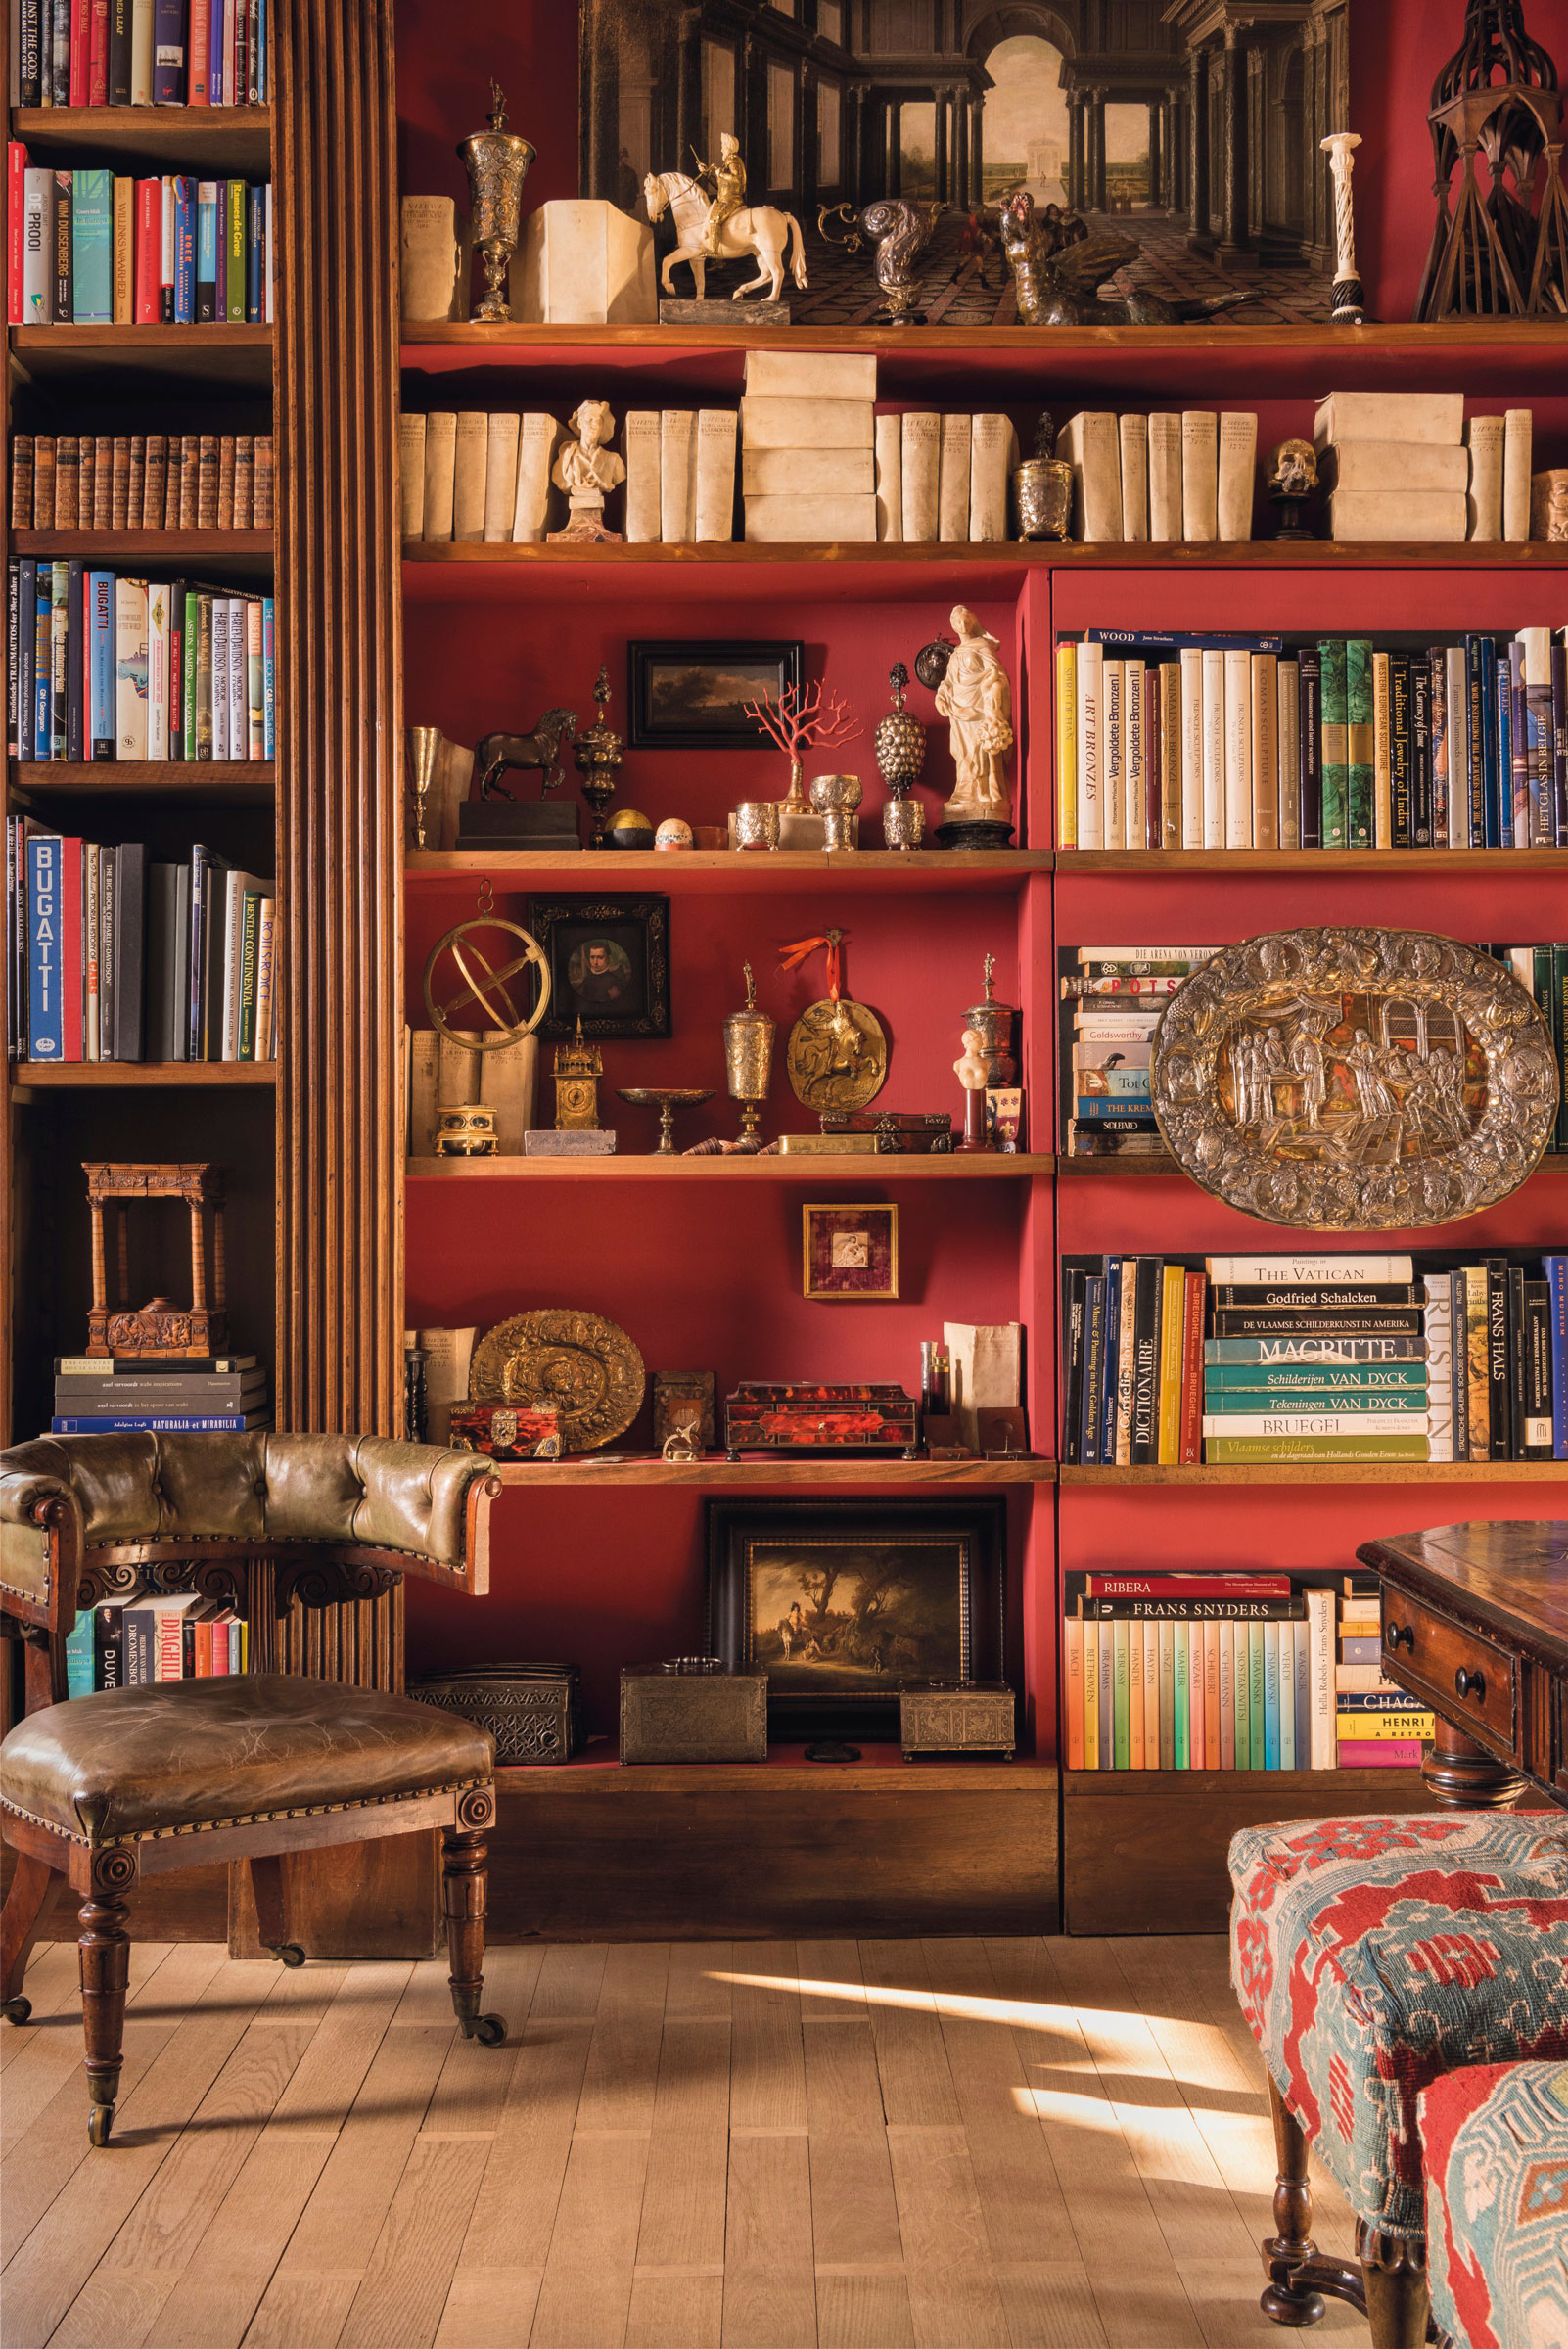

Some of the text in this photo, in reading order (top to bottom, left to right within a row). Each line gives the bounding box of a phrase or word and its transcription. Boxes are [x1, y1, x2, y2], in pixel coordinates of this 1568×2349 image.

[22, 55, 27, 64] OF
[28, 1, 37, 80] INST THE GODS
[28, 193, 41, 251] DE PROOI
[58, 200, 68, 219] WIM
[118, 203, 126, 247] WILLINKS
[233, 184, 242, 257] Ramses de Grote
[58, 220, 68, 276] DUISENBERG
[118, 249, 126, 299] WAARHEID
[97, 582, 108, 630] BUGATTI
[9, 577, 17, 724] Französische TRAUMAUTOS der 30er Jahre
[201, 601, 210, 673] Leerboek NAVIGATIE
[214, 612, 227, 672] HARLEY-DAVIDSON
[231, 612, 243, 672] HARLEY-DAVIDSON
[250, 607, 260, 653] MASERATI
[39, 689, 46, 699] GN
[1064, 667, 1073, 740] SPIRIT OF HAN
[1130, 679, 1140, 722] Bronzen
[1379, 661, 1387, 771] WESTERN EUROPEAN SCULPTURE
[1085, 694, 1096, 800] ART BRONZES
[1130, 724, 1142, 778] Vergoldete
[1168, 671, 1177, 784] ANIMALS IN BRONZE
[1394, 671, 1409, 826] Traditional Jewelry of India
[1534, 714, 1549, 831] HET GLAS IN BELGIË
[36, 846, 53, 1012] BUGATTI
[105, 909, 112, 921] OF
[1090, 1031, 1142, 1040] Goldsworthy
[1119, 1078, 1139, 1089] Tot
[1254, 1269, 1365, 1281] THE VATICAN
[1266, 1293, 1377, 1304] Godfried Schalcken
[1258, 1340, 1397, 1361] MAGRITTE
[1492, 1292, 1506, 1380] FRANS HALS
[1136, 1339, 1153, 1443] DICTIONAIRE
[1268, 1373, 1408, 1386] Schilderijen VAN DYCK
[1428, 1296, 1451, 1441] RUSTIN
[153, 1420, 237, 1429] NATURALIA et MIRABILIA
[1105, 1396, 1113, 1458] Johannes Vermeer
[1263, 1419, 1345, 1434] BRUEGEL
[1270, 1398, 1408, 1411] Tekeningen VAN DYCK
[1228, 1441, 1314, 1453] Vlaamse schilders
[1105, 1582, 1151, 1593] RIBERA
[1134, 1604, 1269, 1616] FRANS SNYDERS
[1318, 1600, 1328, 1632] Snyders
[104, 1650, 115, 1688] DUVE
[1070, 1649, 1079, 1676] BACH
[1222, 1650, 1230, 1707] SCHUMANN
[1238, 1650, 1246, 1720] SJOSTAKOVITSJ
[1268, 1650, 1277, 1705] TSJAIKOVSKI
[1283, 1651, 1291, 1680] VERDI
[1382, 1718, 1424, 1726] HENRI
[1393, 1749, 1417, 1759] Mark
